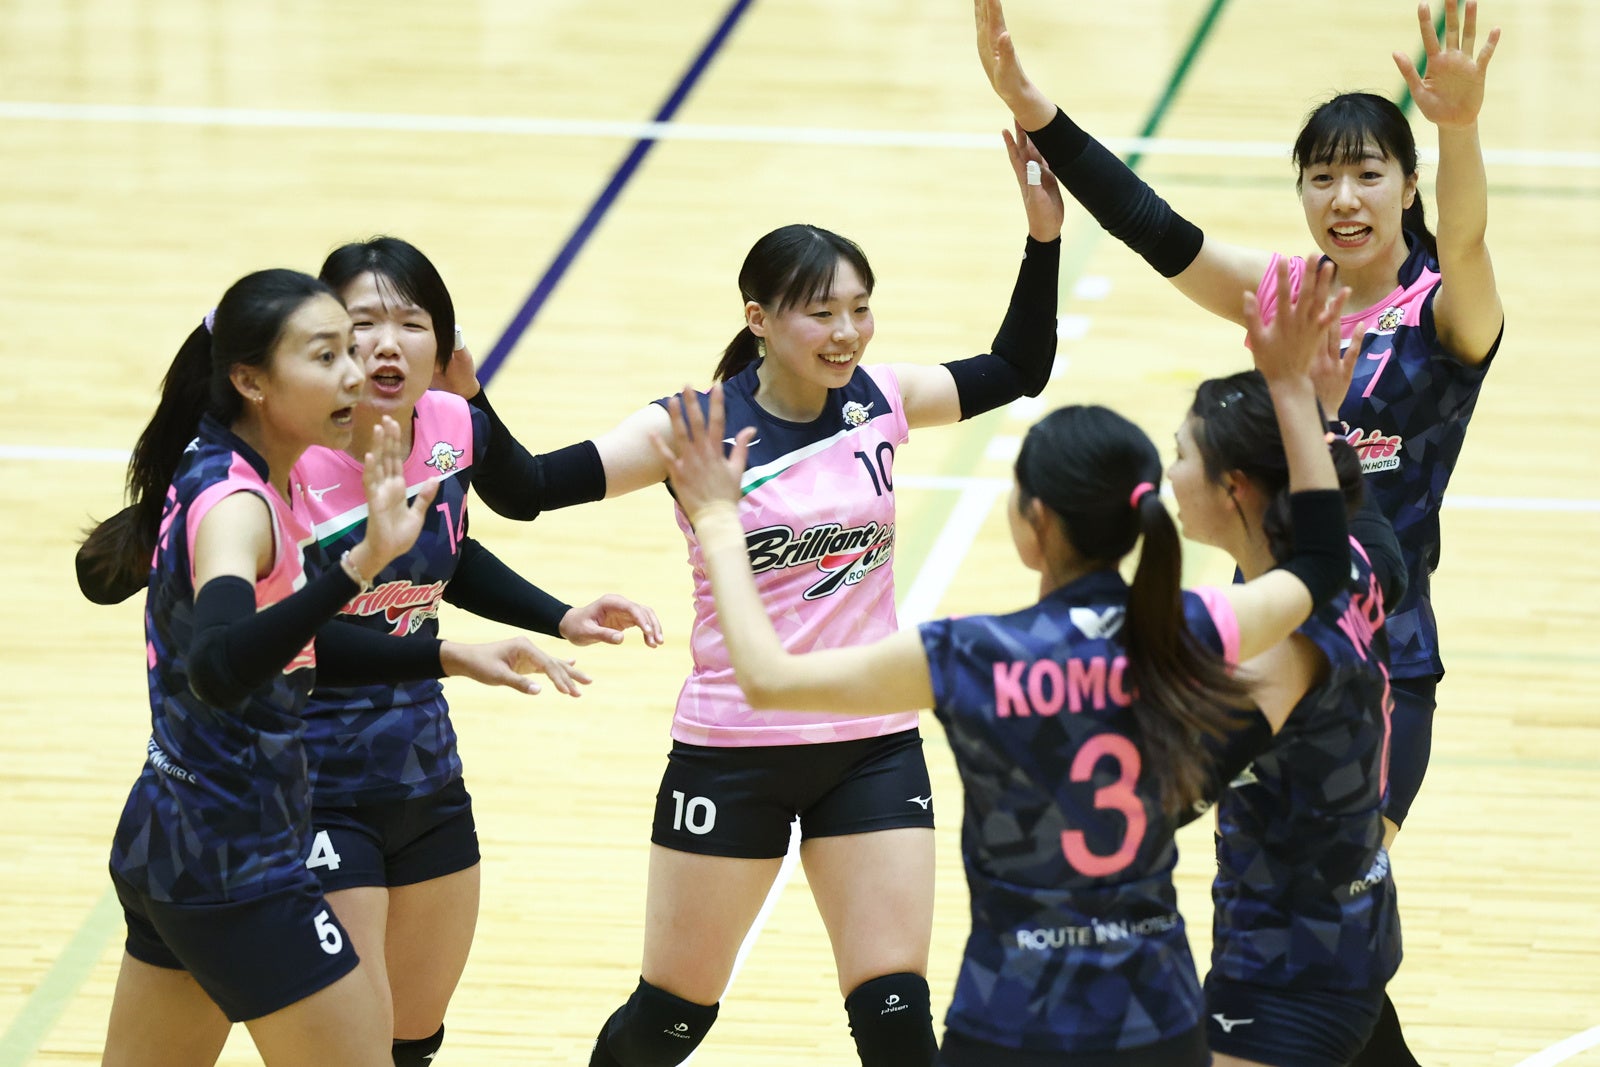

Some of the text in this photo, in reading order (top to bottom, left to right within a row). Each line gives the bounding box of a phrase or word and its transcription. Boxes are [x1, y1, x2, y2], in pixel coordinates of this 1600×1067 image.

[1362, 348, 1392, 398] 7
[854, 441, 894, 496] 10
[744, 525, 876, 572] Brilliant
[340, 582, 441, 616] rilliant
[672, 790, 717, 835] 10
[1060, 733, 1147, 877] 3
[314, 910, 343, 955] 5
[1016, 926, 1091, 950] ROUTE
